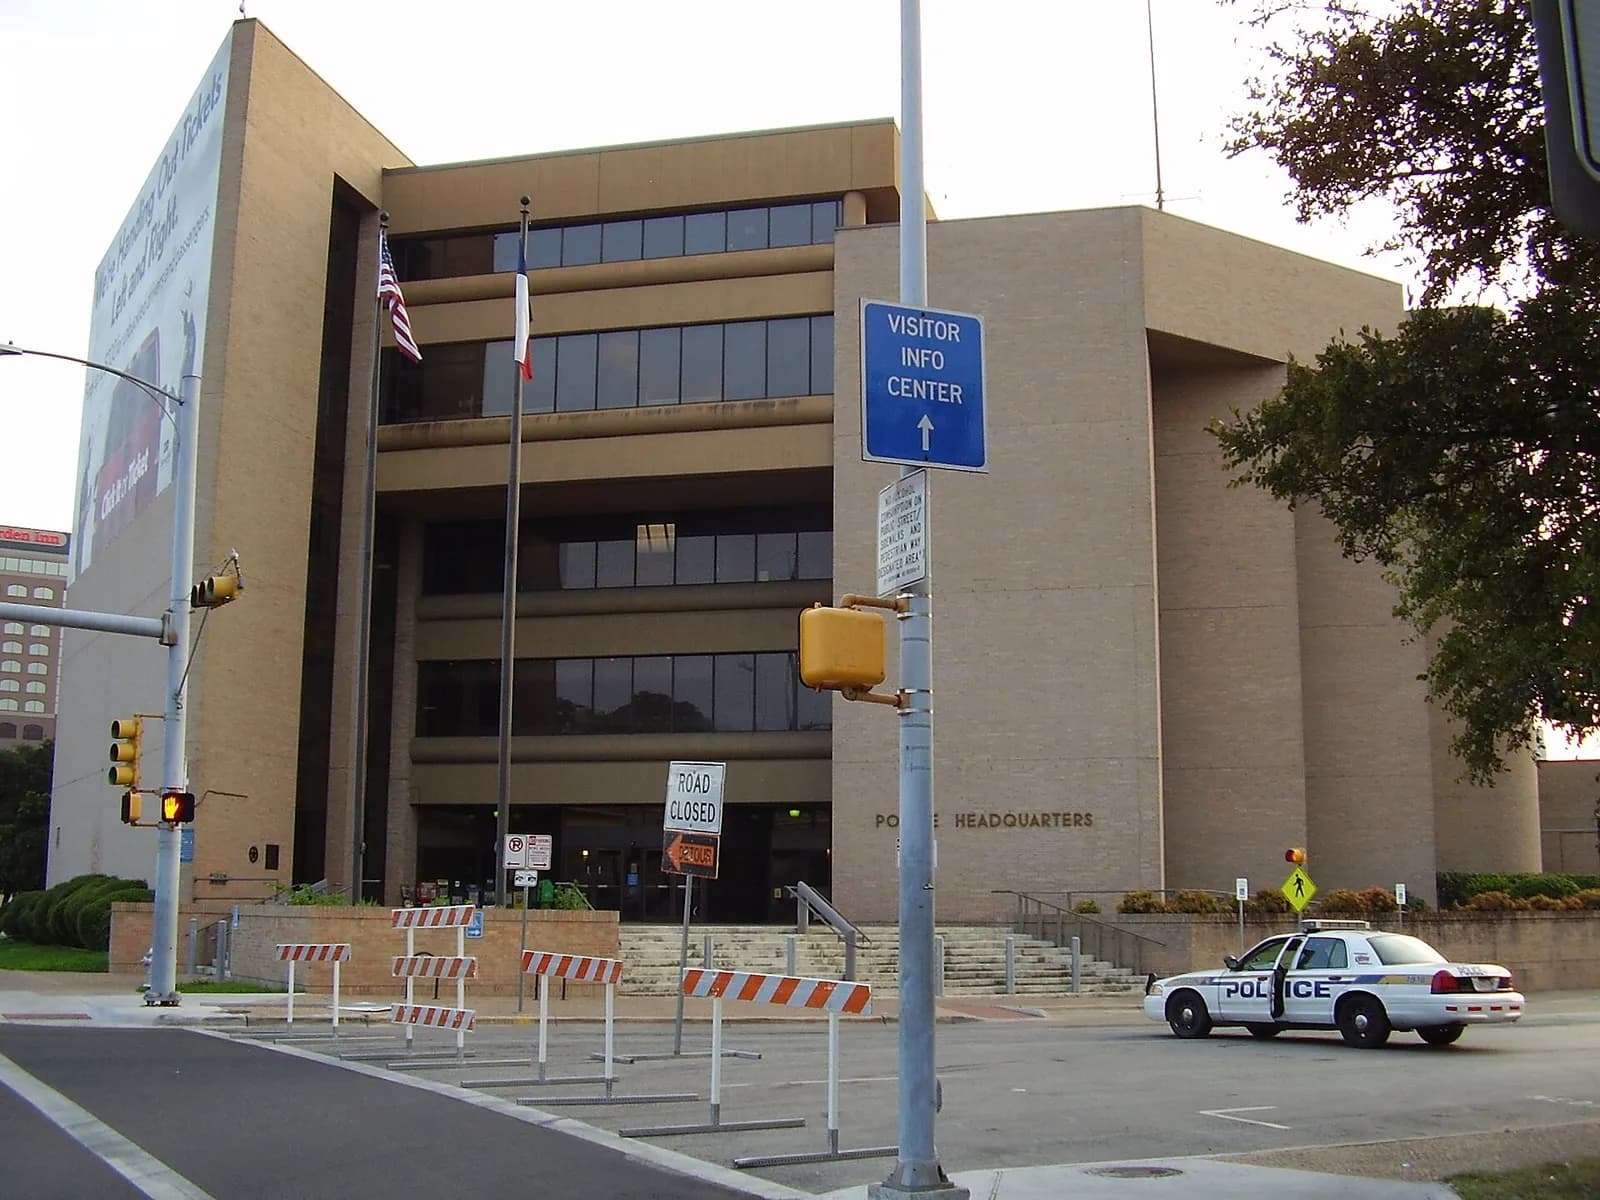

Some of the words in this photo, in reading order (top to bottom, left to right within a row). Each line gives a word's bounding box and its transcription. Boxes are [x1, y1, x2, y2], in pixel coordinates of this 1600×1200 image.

[157, 138, 179, 201] Out
[181, 72, 222, 161] Tickets
[888, 313, 961, 343] VISITOR
[902, 346, 945, 370] INFO
[887, 376, 963, 405] CENTER
[914, 495, 922, 507] ON
[34, 531, 60, 545] Inn
[910, 522, 921, 536] AND
[909, 536, 921, 552] WAY
[678, 773, 711, 794] ROAD
[670, 800, 716, 823] CLOSED
[875, 813, 939, 828] POE
[955, 812, 1093, 828] HEADQUARTERS
[1226, 980, 1332, 999] POLICE
